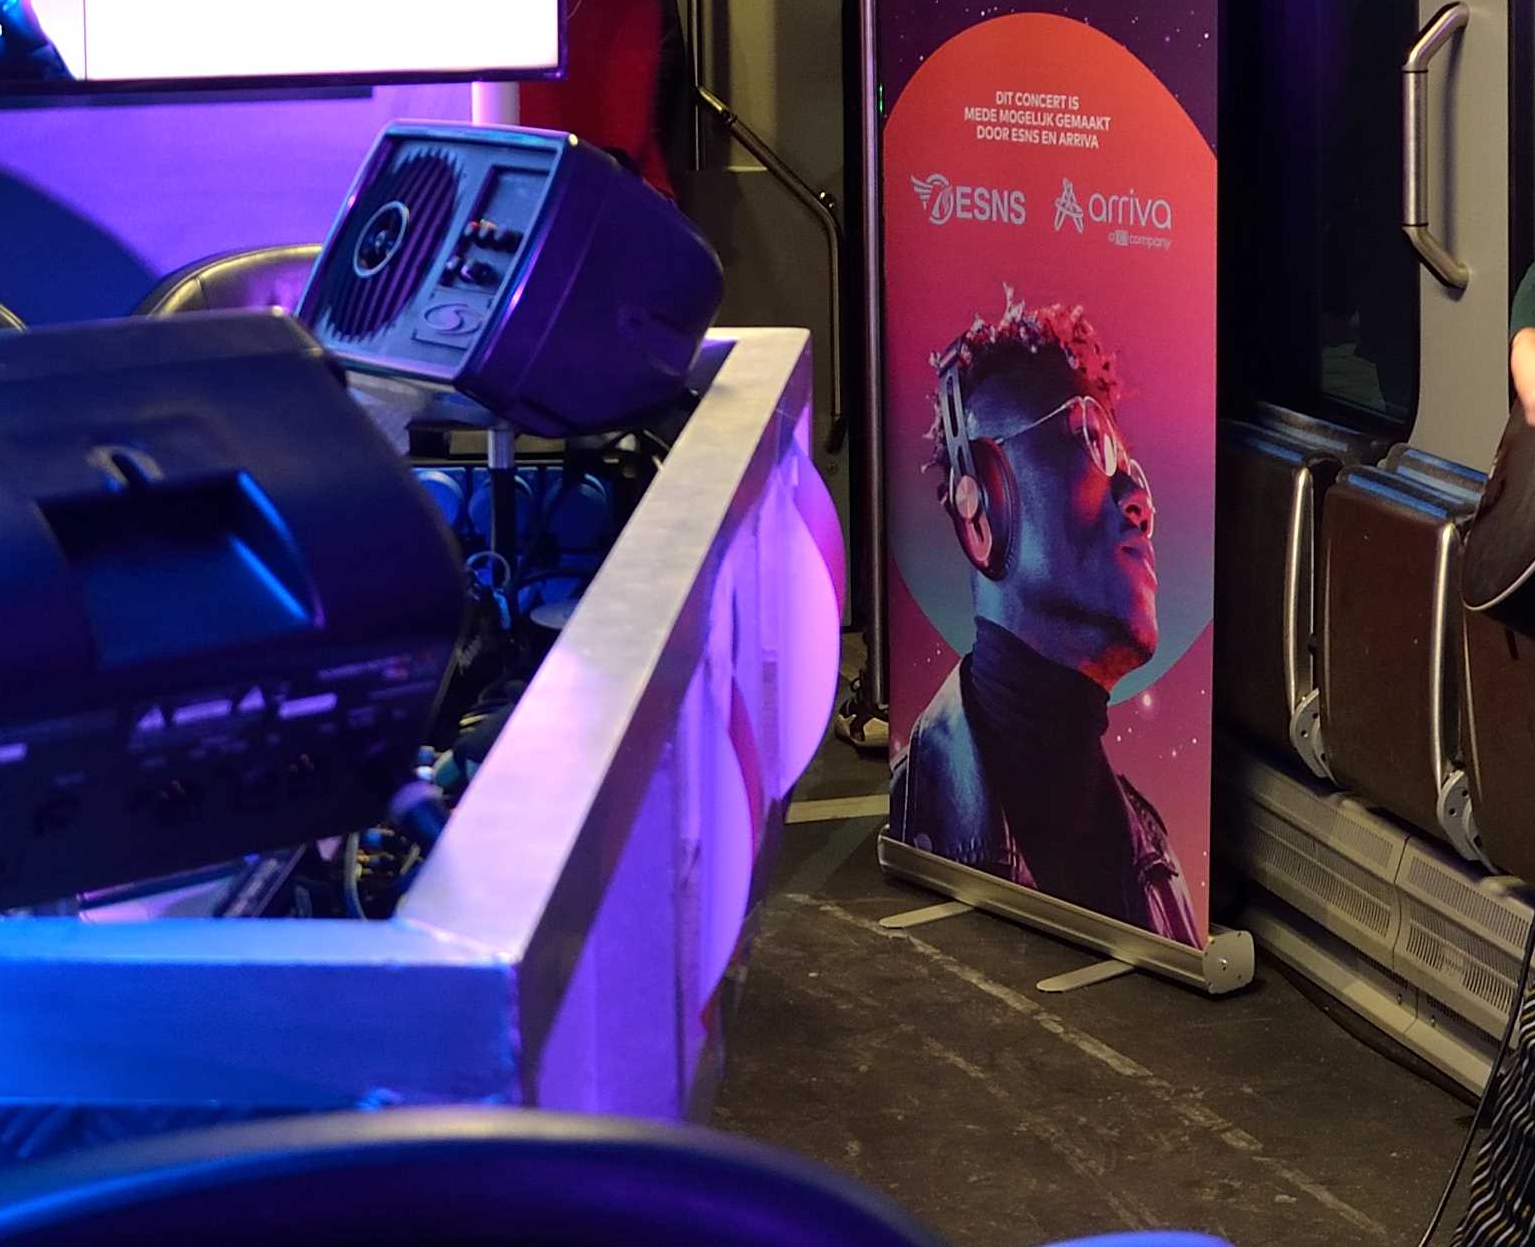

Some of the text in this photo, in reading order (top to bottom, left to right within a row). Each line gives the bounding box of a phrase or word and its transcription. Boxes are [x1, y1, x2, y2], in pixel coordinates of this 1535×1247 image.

[995, 90, 1080, 110] DIT CONCERT IS
[964, 106, 1112, 131] MEDE MOGELIJK GEMAAKT
[976, 125, 1100, 149] DOOR ESNS EN ARRIVA
[957, 186, 1026, 226] ESNS
[1088, 188, 1172, 230] arriva
